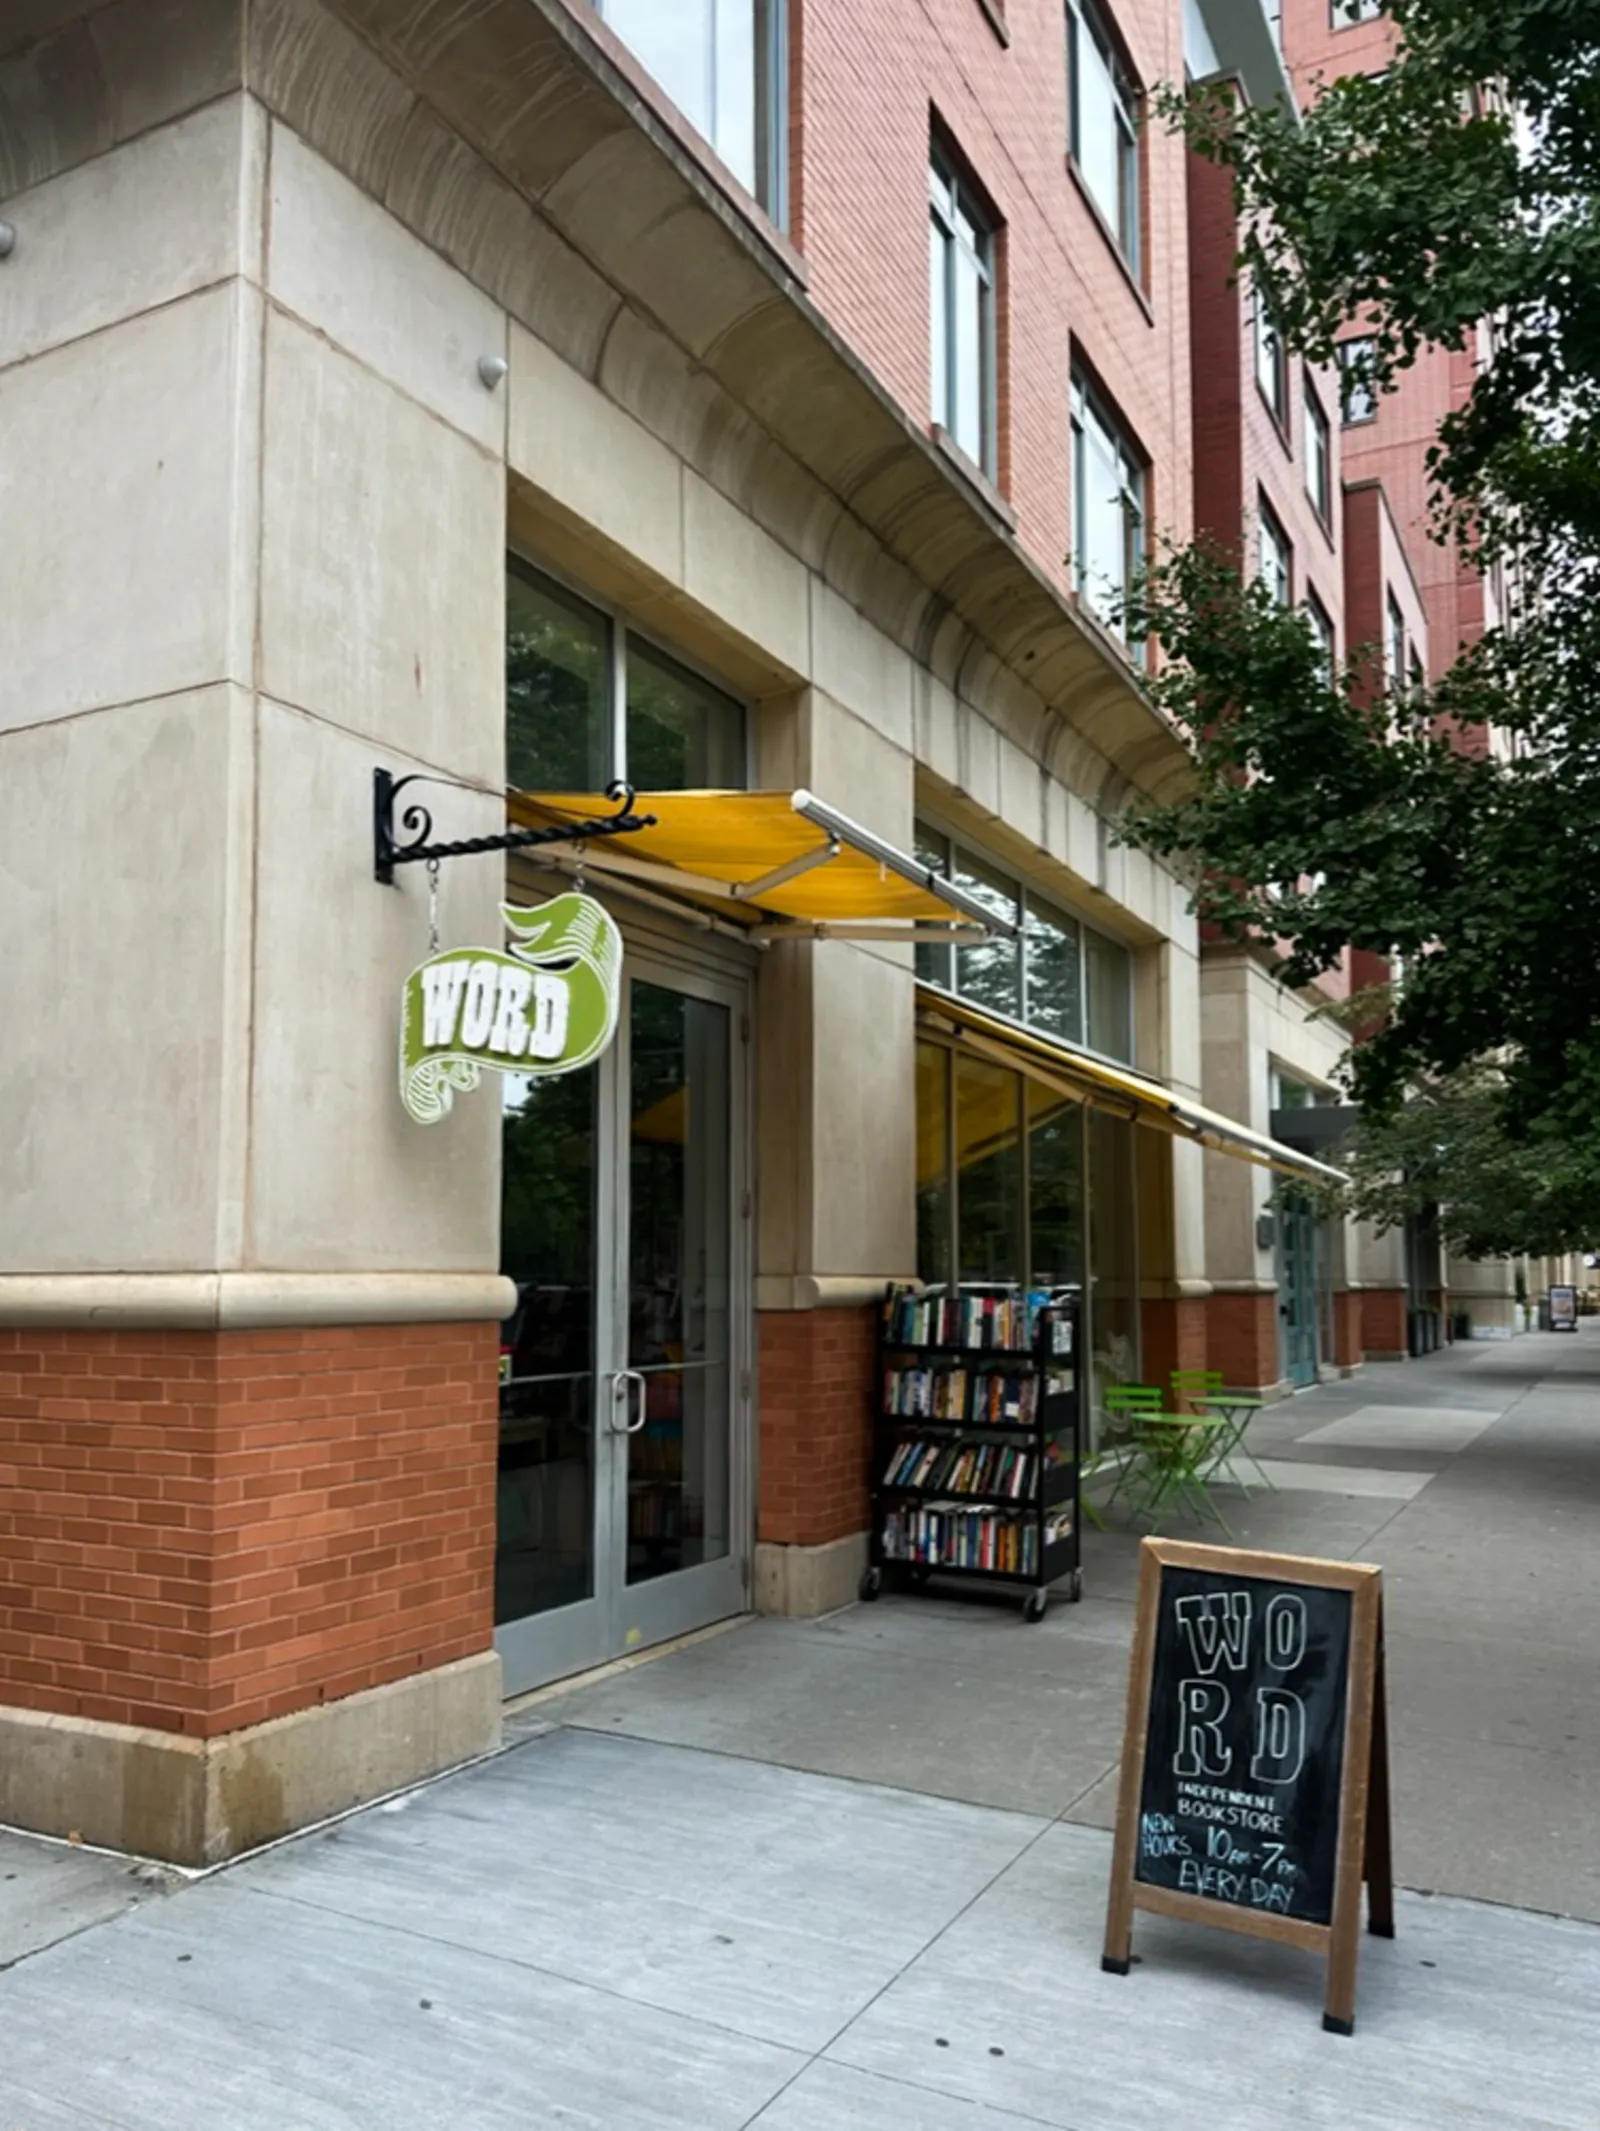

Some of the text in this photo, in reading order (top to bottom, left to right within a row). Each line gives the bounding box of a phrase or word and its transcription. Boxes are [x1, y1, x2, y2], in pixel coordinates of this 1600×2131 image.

[420, 959, 569, 1059] WORD
[1177, 1781, 1275, 1812] INDEPENDENT
[1142, 1812, 1176, 1834] NEW
[1177, 1798, 1284, 1835] BOOKSTORE
[1142, 1834, 1193, 1858] HOURS
[1178, 1859, 1295, 1914] EVERY DAY
